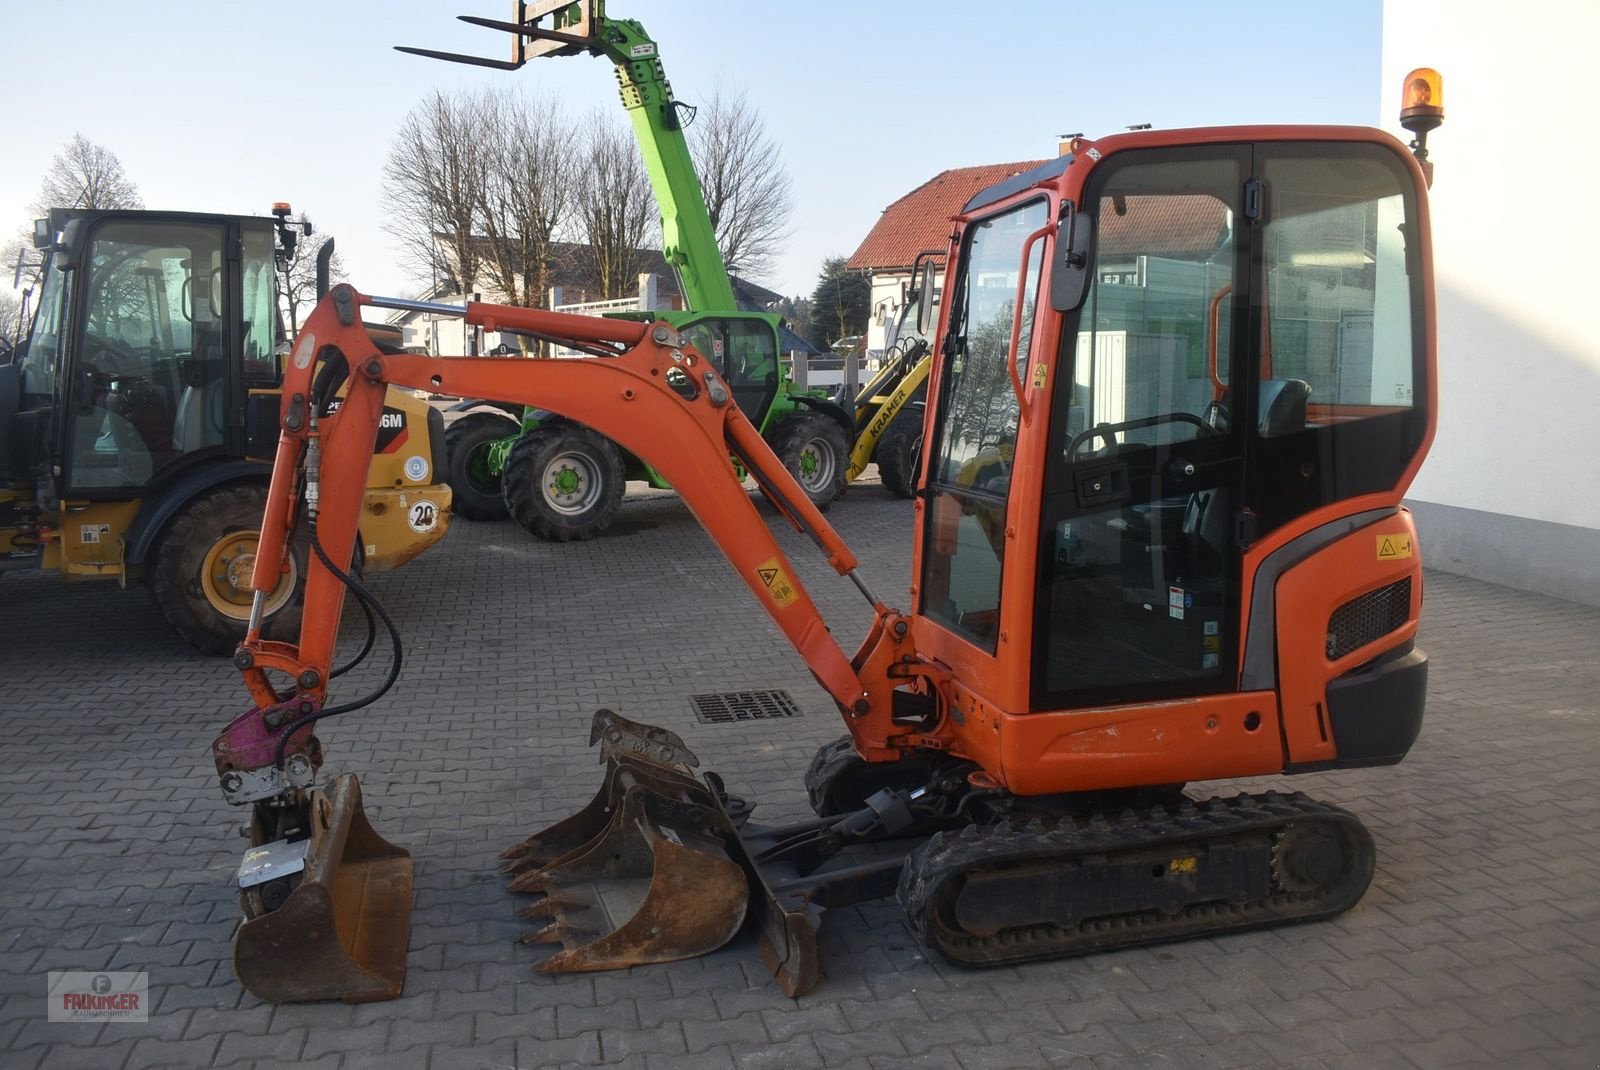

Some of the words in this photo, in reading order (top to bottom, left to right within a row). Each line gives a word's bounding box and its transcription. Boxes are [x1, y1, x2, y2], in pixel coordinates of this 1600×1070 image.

[379, 414, 402, 428] 6M
[870, 390, 906, 437] KRAMER
[414, 505, 433, 526] 20
